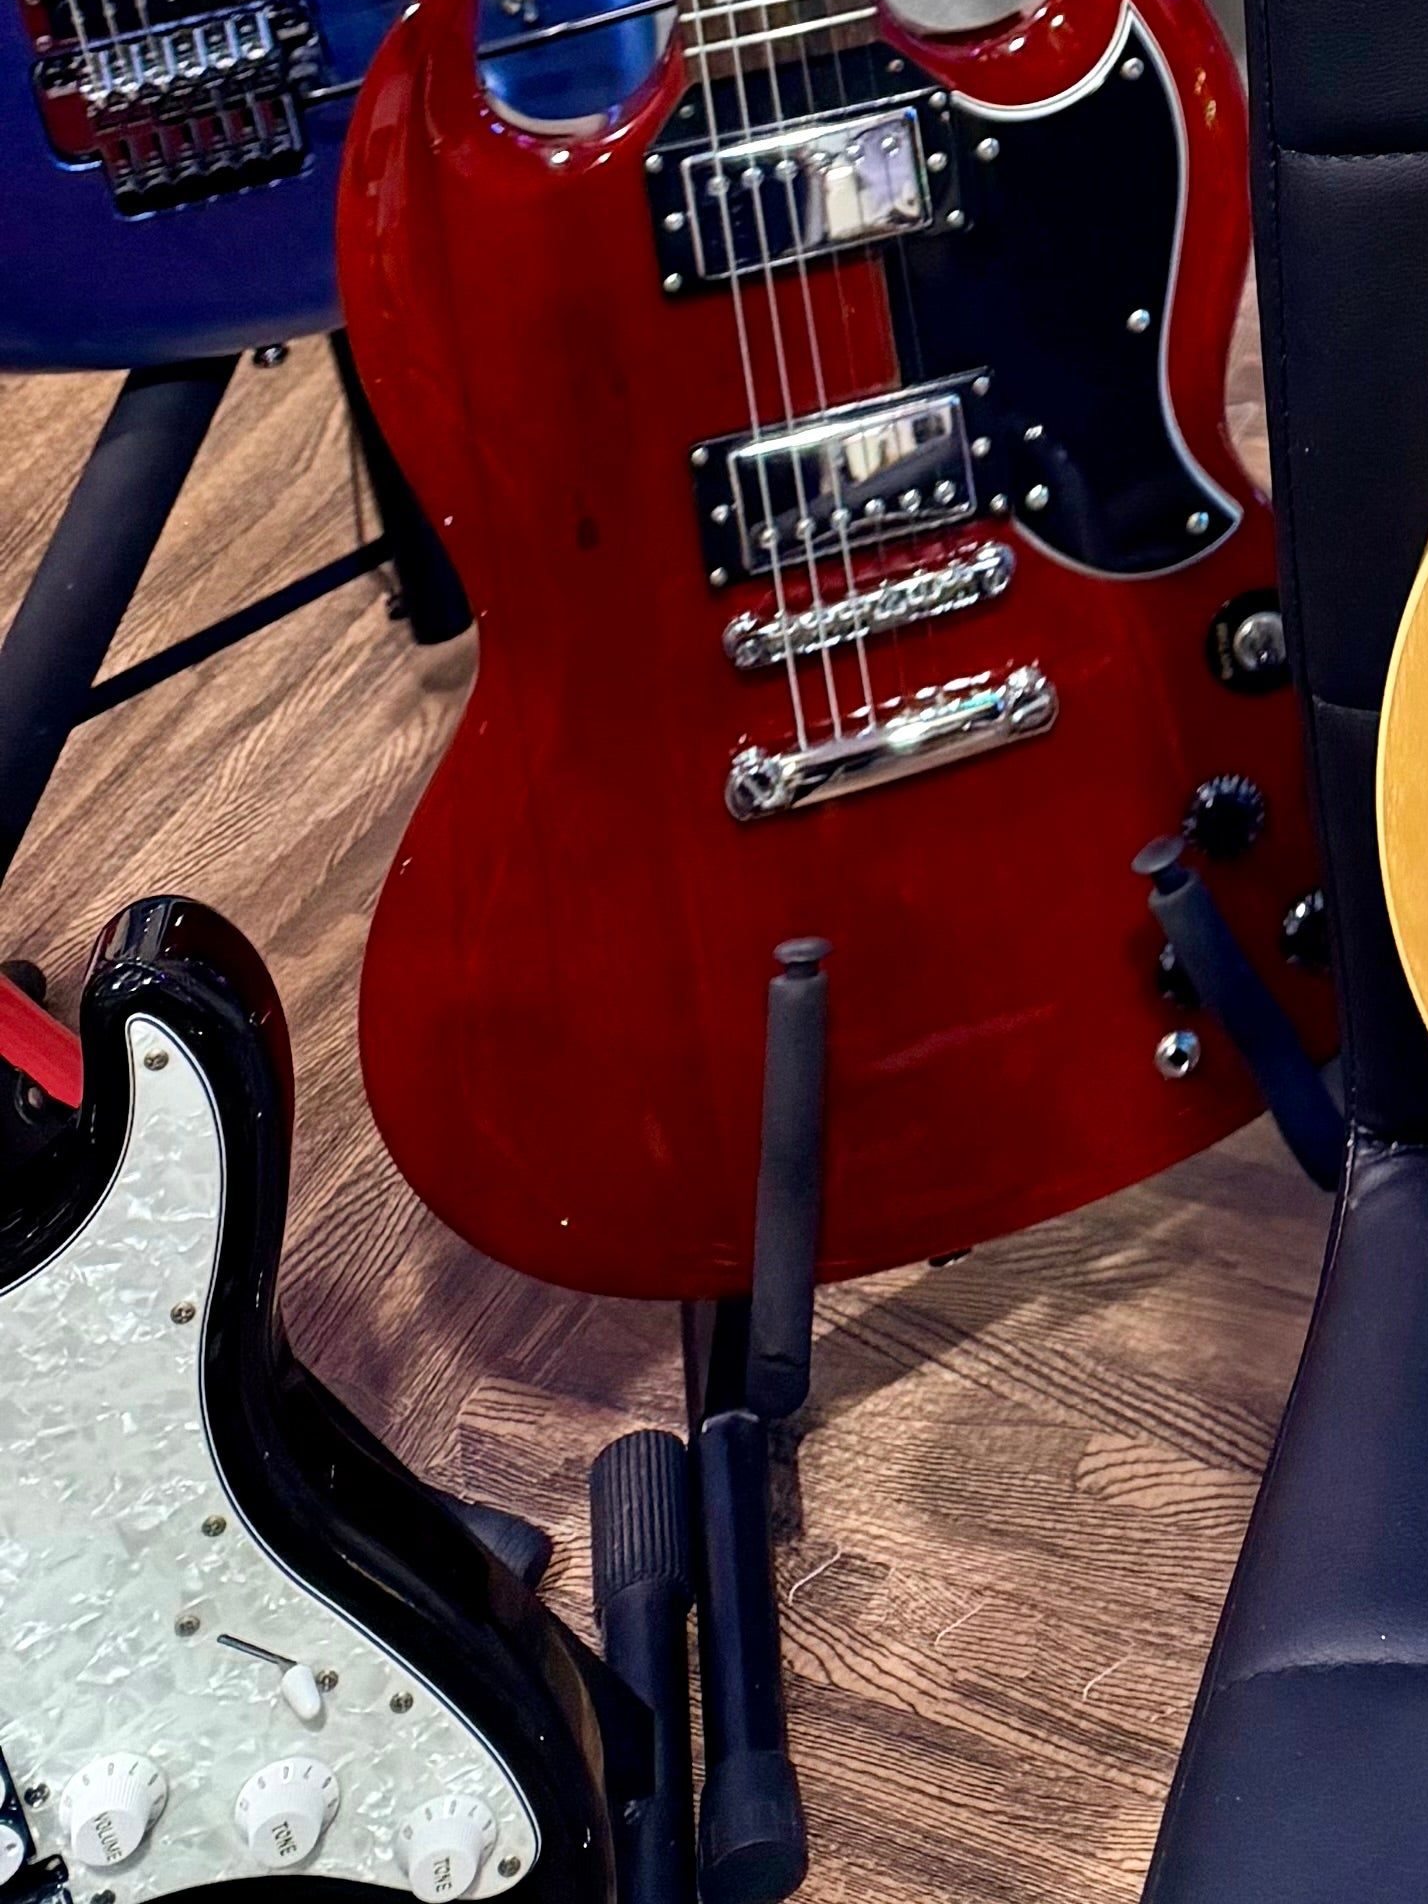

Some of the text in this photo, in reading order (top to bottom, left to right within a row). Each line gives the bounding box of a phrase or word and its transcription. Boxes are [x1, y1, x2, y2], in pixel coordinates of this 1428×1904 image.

[94, 1811, 122, 1862] VOLUME
[271, 1821, 297, 1857] TONE
[433, 1856, 453, 1893] TONE
